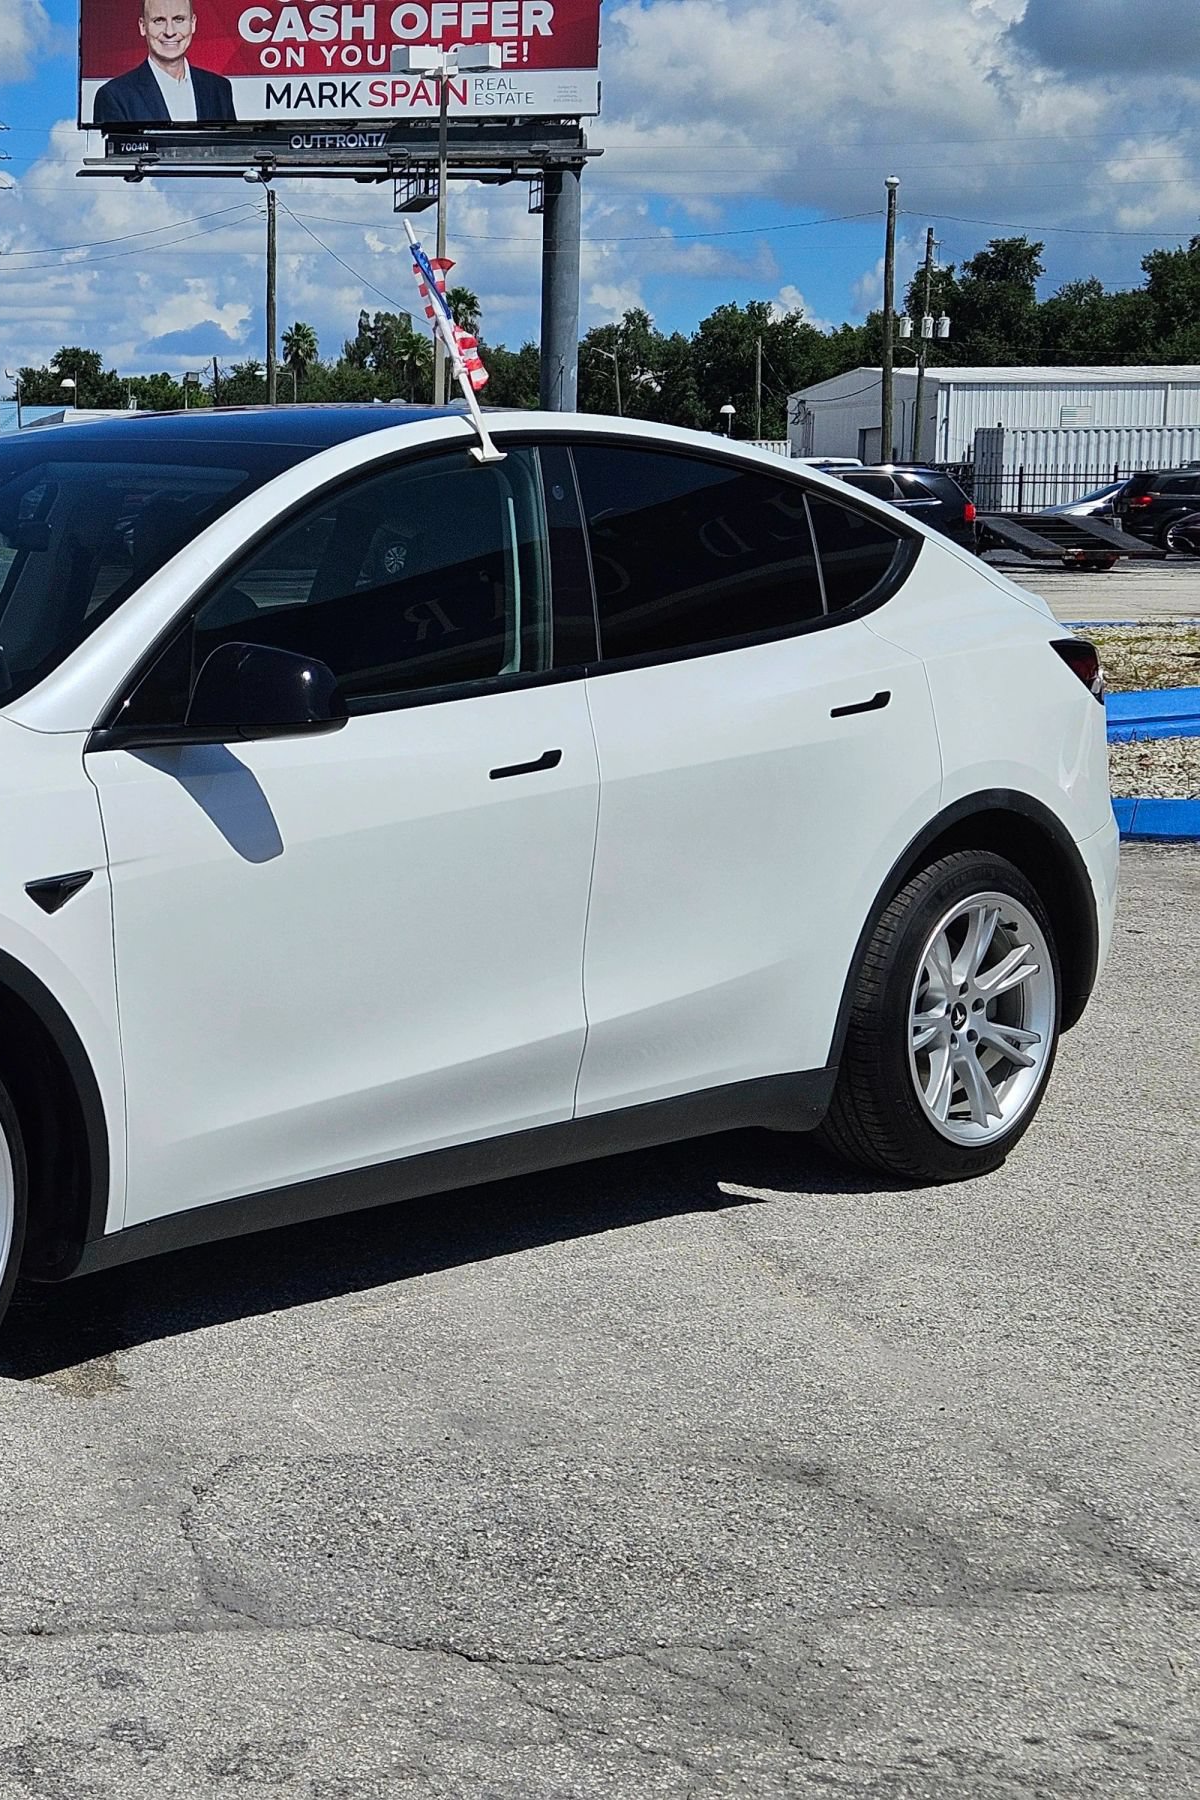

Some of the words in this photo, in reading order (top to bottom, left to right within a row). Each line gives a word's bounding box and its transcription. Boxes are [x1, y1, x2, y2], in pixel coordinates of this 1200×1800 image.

[237, 3, 376, 43] CASH
[390, 0, 555, 40] OFFER
[259, 46, 306, 68] ON
[319, 44, 406, 67] YOU
[474, 78, 518, 91] REAL
[264, 80, 363, 111] MARK
[368, 79, 468, 107] SPAIN
[474, 91, 535, 105] ESTATE
[121, 142, 149, 152] 7004N
